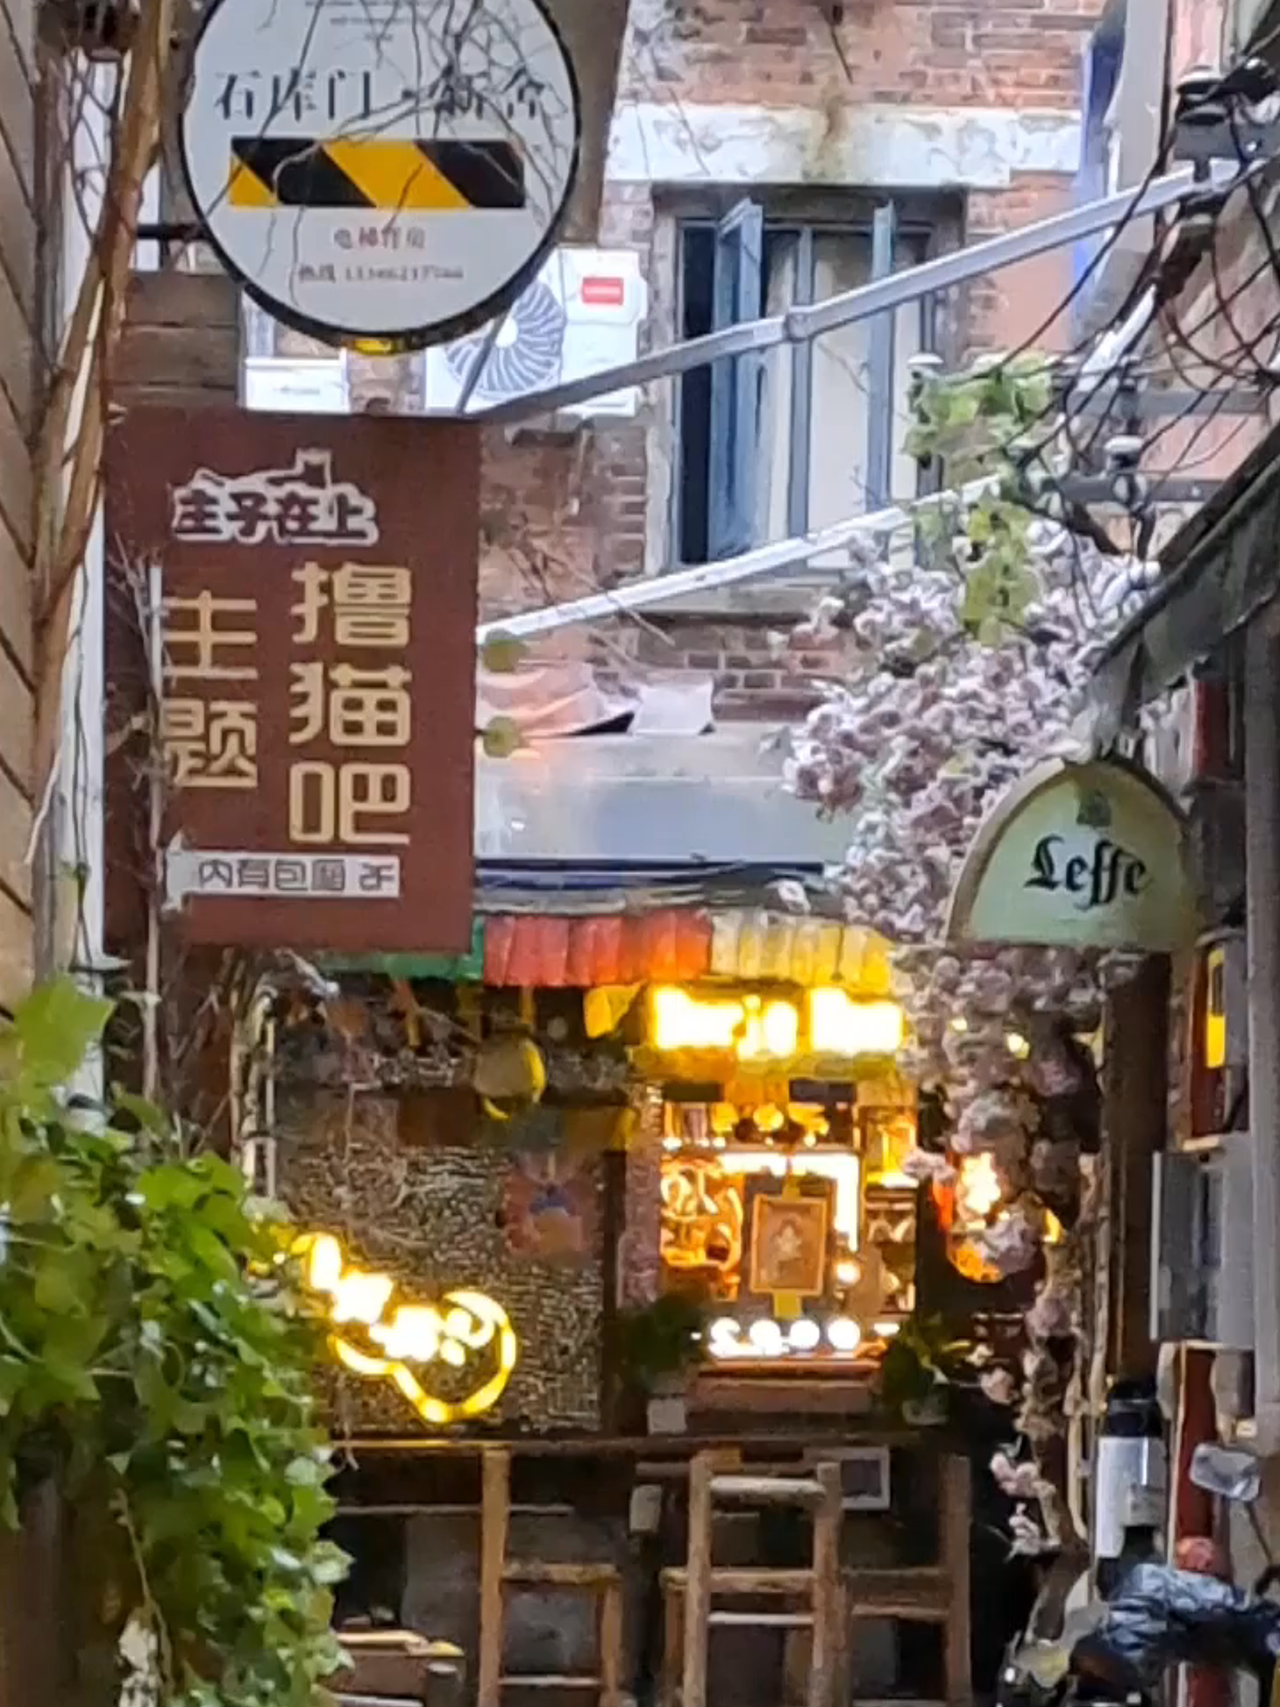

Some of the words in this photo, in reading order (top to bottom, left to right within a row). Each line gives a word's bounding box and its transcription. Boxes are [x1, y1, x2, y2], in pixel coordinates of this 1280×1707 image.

[163, 589, 259, 789] 主题
[289, 561, 412, 845] 撸猫吧
[1023, 833, 1151, 912] Leffe
